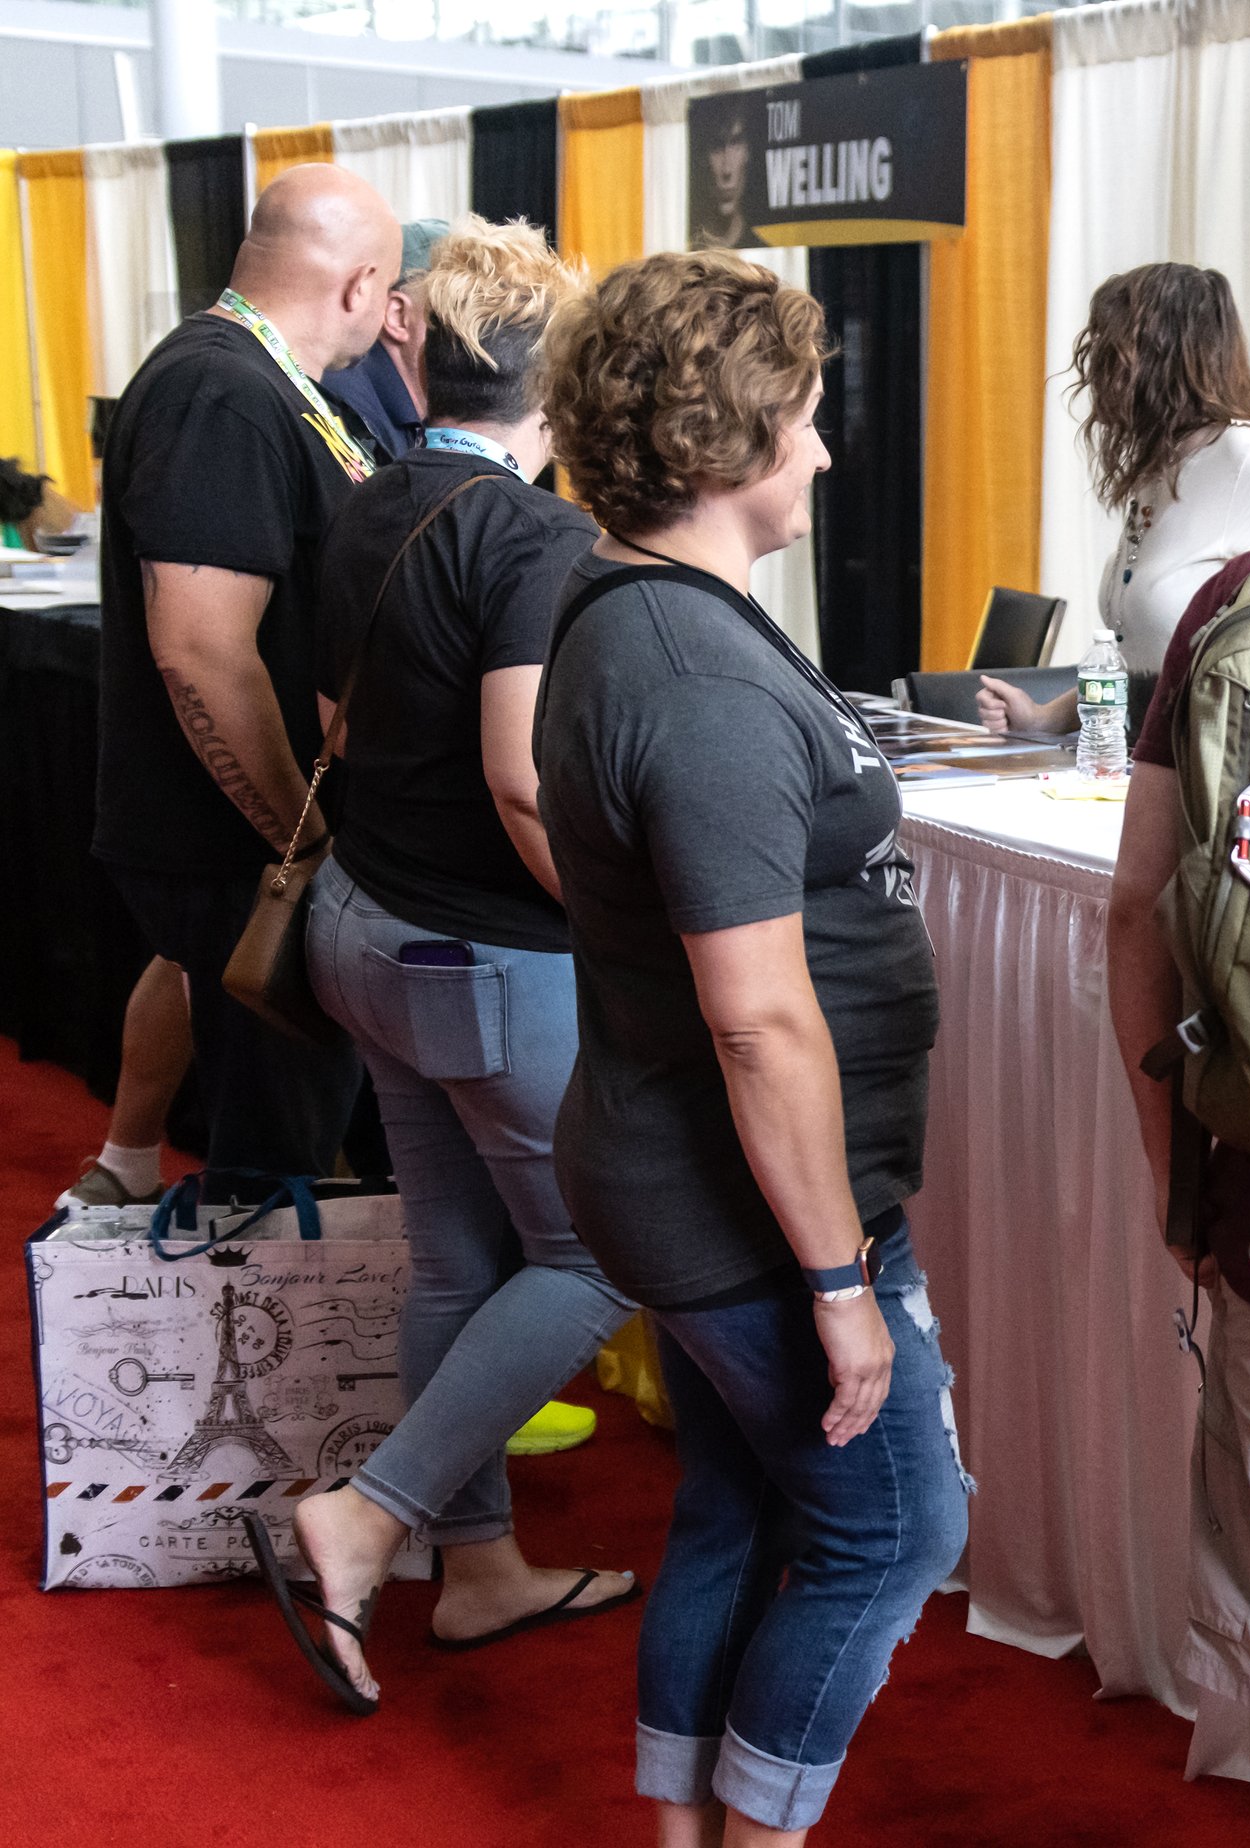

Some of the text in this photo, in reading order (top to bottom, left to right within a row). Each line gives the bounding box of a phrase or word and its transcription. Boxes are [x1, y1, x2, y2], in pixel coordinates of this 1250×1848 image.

[766, 100, 799, 143] TOM
[765, 136, 893, 209] WELLING
[122, 1275, 196, 1298] PARIS
[326, 1422, 363, 1455] PARIS
[139, 1536, 208, 1550] CARTE
